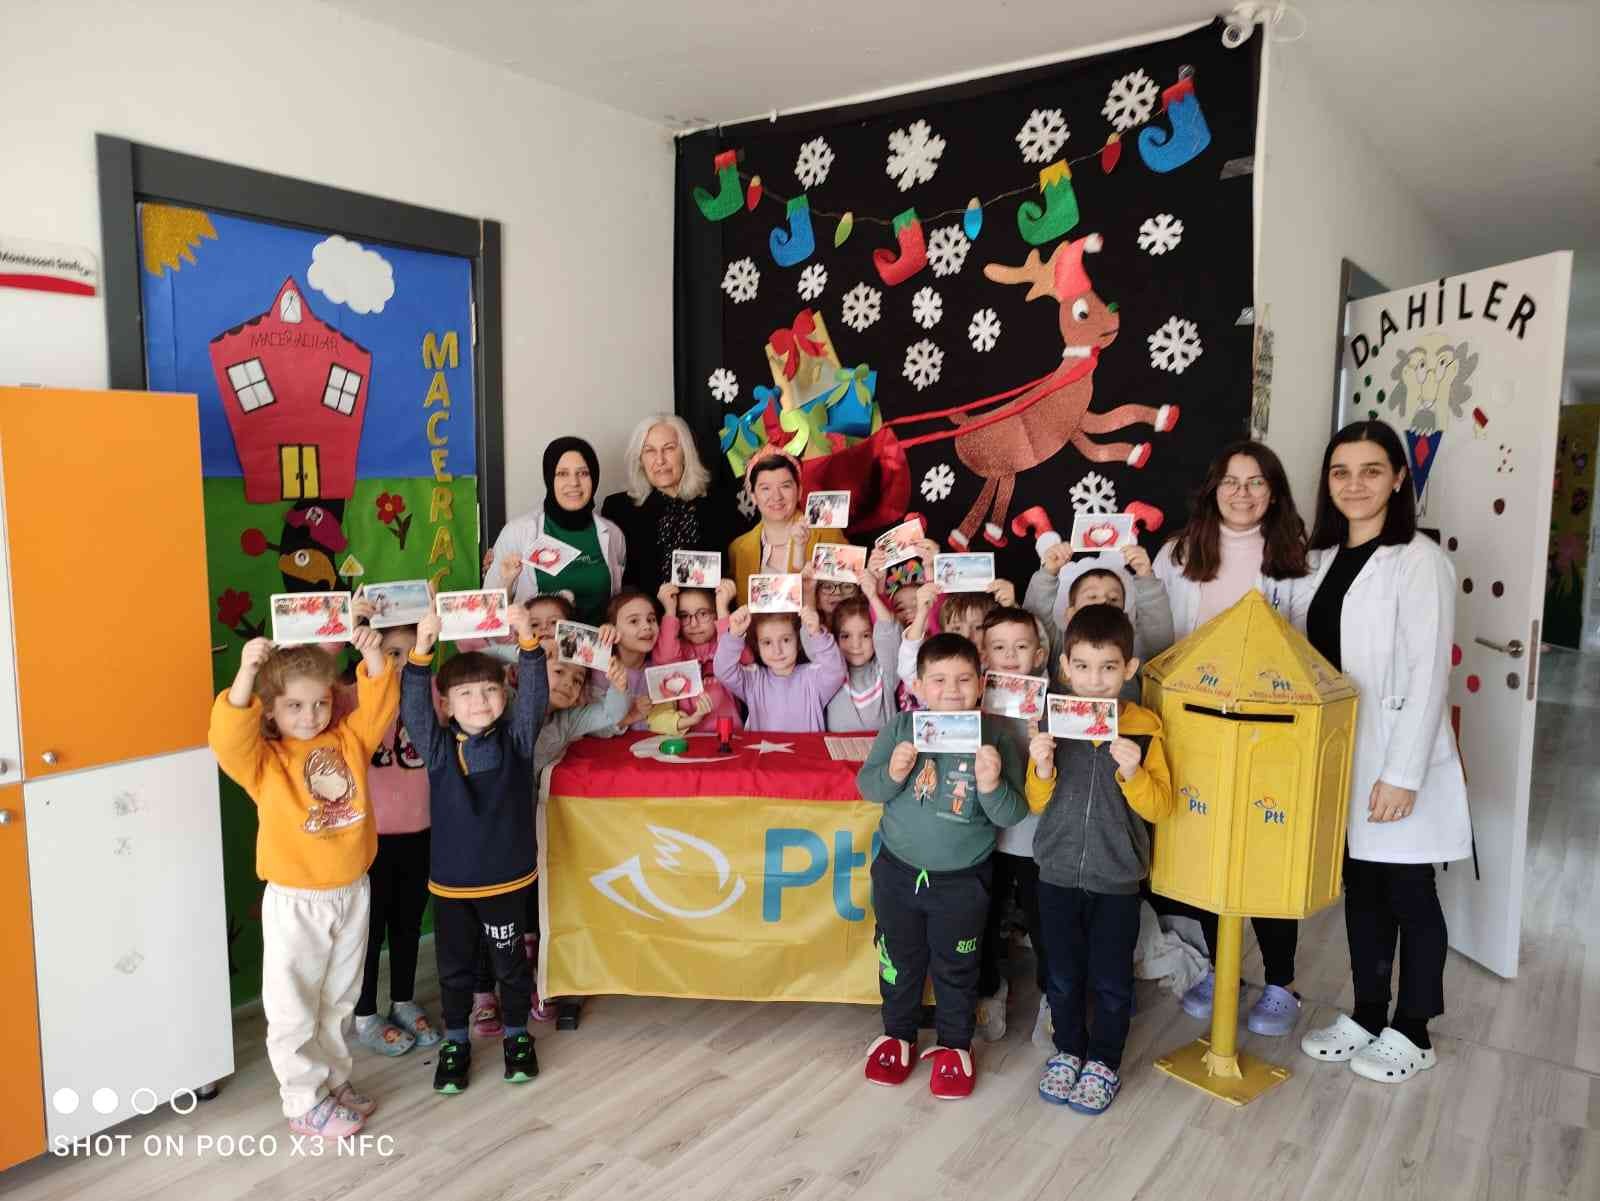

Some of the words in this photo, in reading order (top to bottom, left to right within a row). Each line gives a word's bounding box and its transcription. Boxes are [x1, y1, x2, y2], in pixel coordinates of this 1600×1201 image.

[1350, 279, 1536, 369] DAHİLER
[1189, 799, 1208, 815] Ptt
[1264, 810, 1285, 824] Ptt
